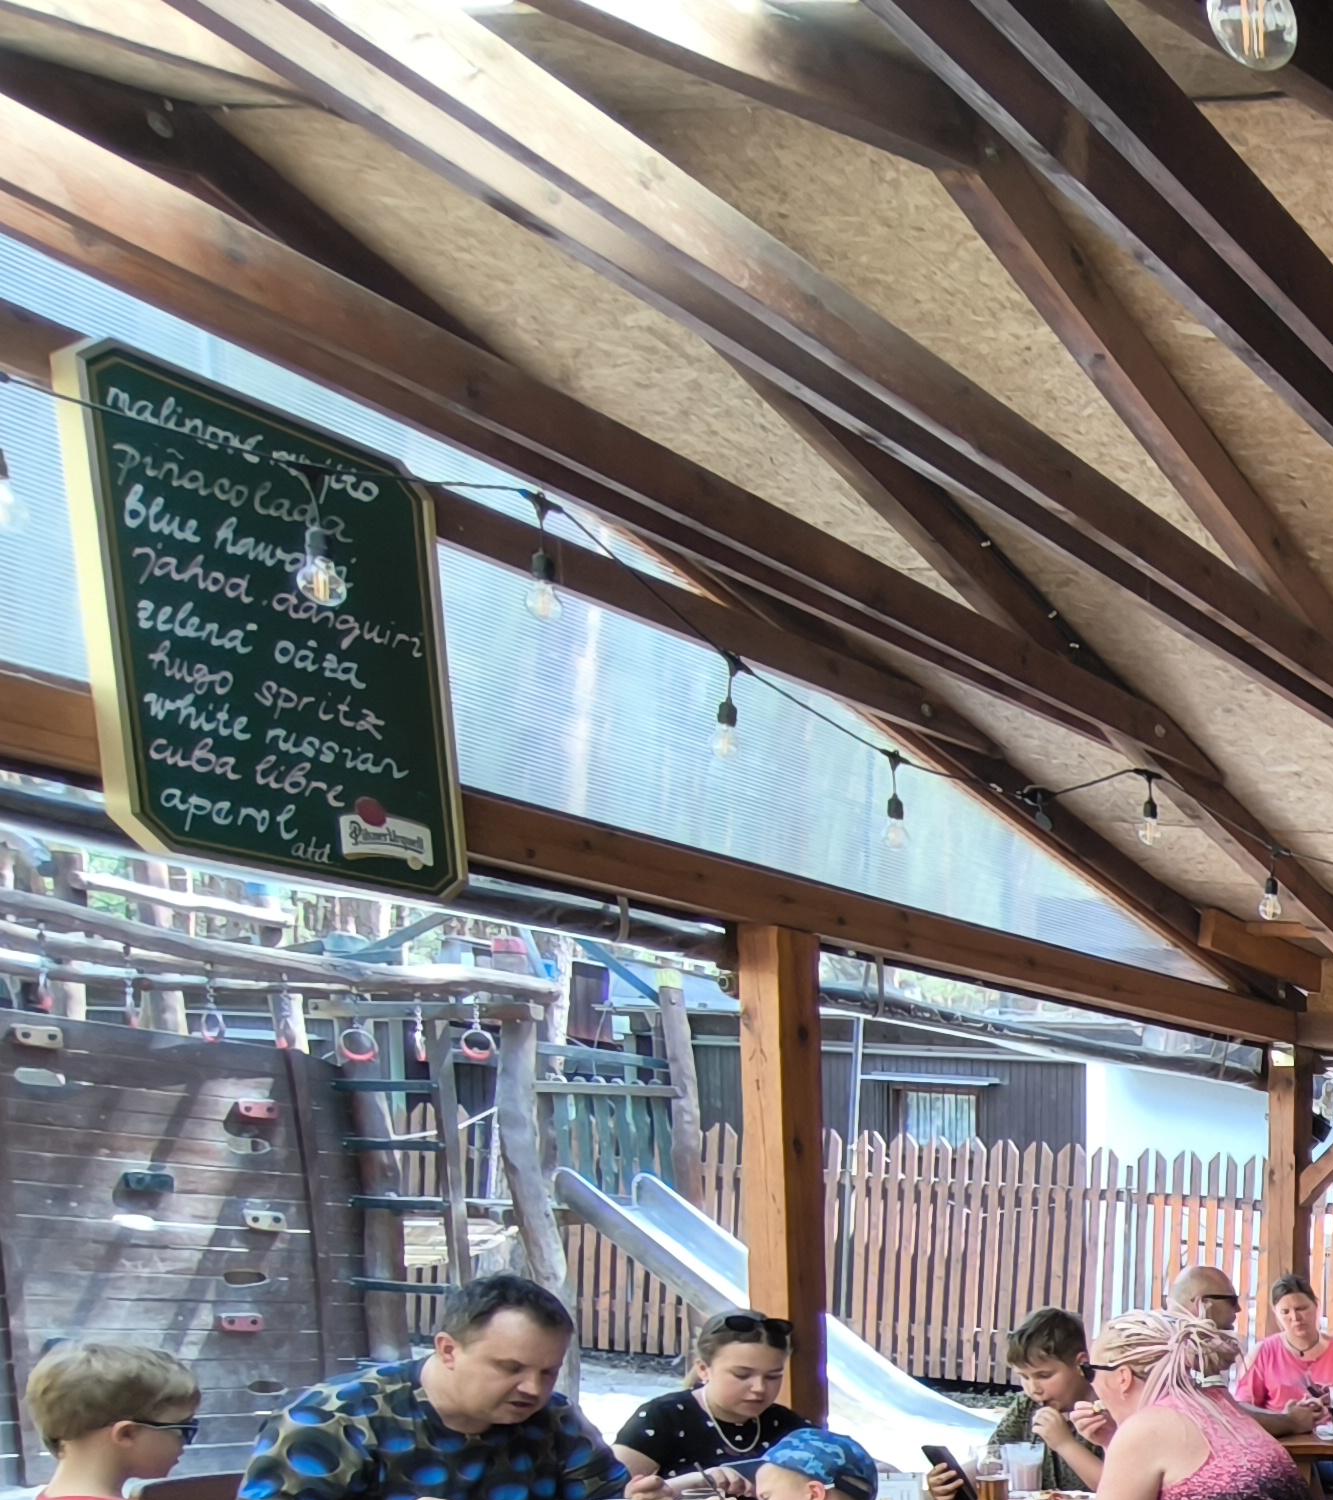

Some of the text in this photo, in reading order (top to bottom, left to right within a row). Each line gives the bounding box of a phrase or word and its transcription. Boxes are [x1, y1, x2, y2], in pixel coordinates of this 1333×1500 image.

[123, 484, 202, 547] blue
[137, 600, 366, 690] zelená oáza
[148, 641, 386, 740] hugo spritz
[144, 691, 410, 779] white russian
[150, 736, 345, 808] cuba libre
[161, 787, 299, 840] aperol
